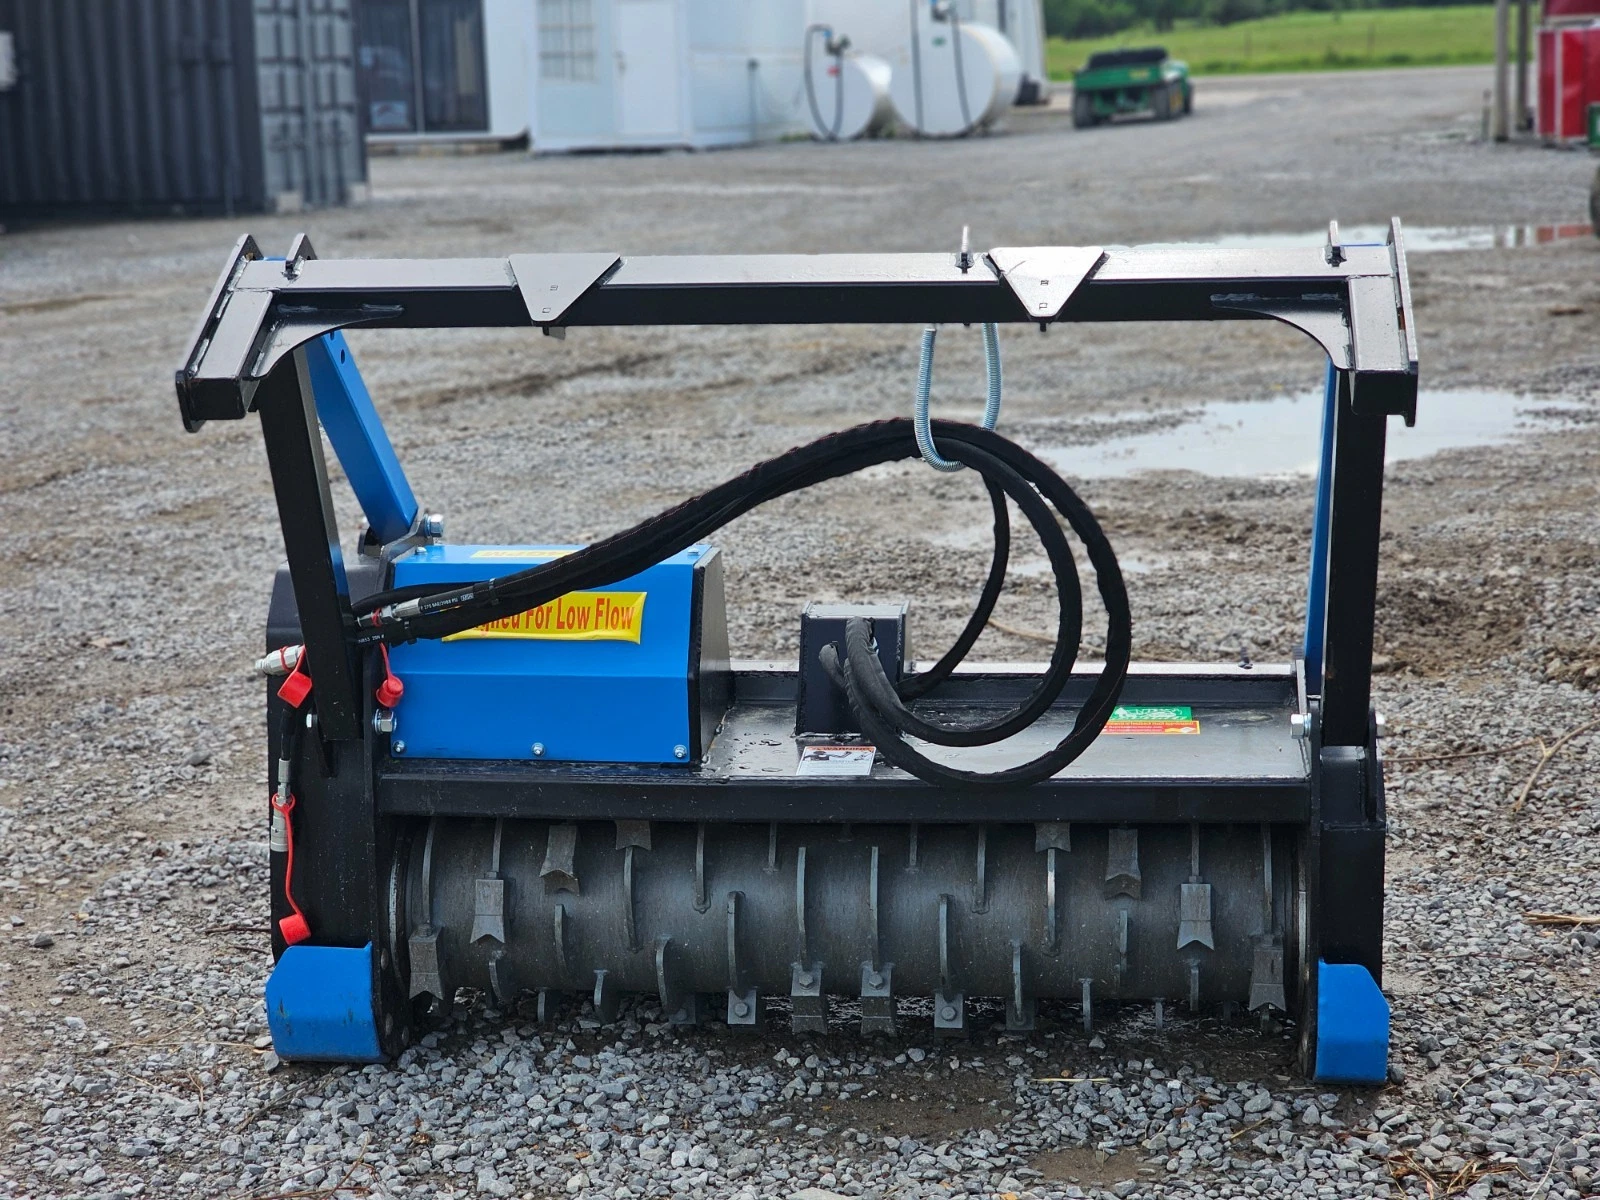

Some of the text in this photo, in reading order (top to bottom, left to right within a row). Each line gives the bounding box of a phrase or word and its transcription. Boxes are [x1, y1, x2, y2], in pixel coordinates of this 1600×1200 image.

[525, 604, 553, 630] For
[556, 597, 591, 631] Low
[594, 597, 635, 631] Flow
